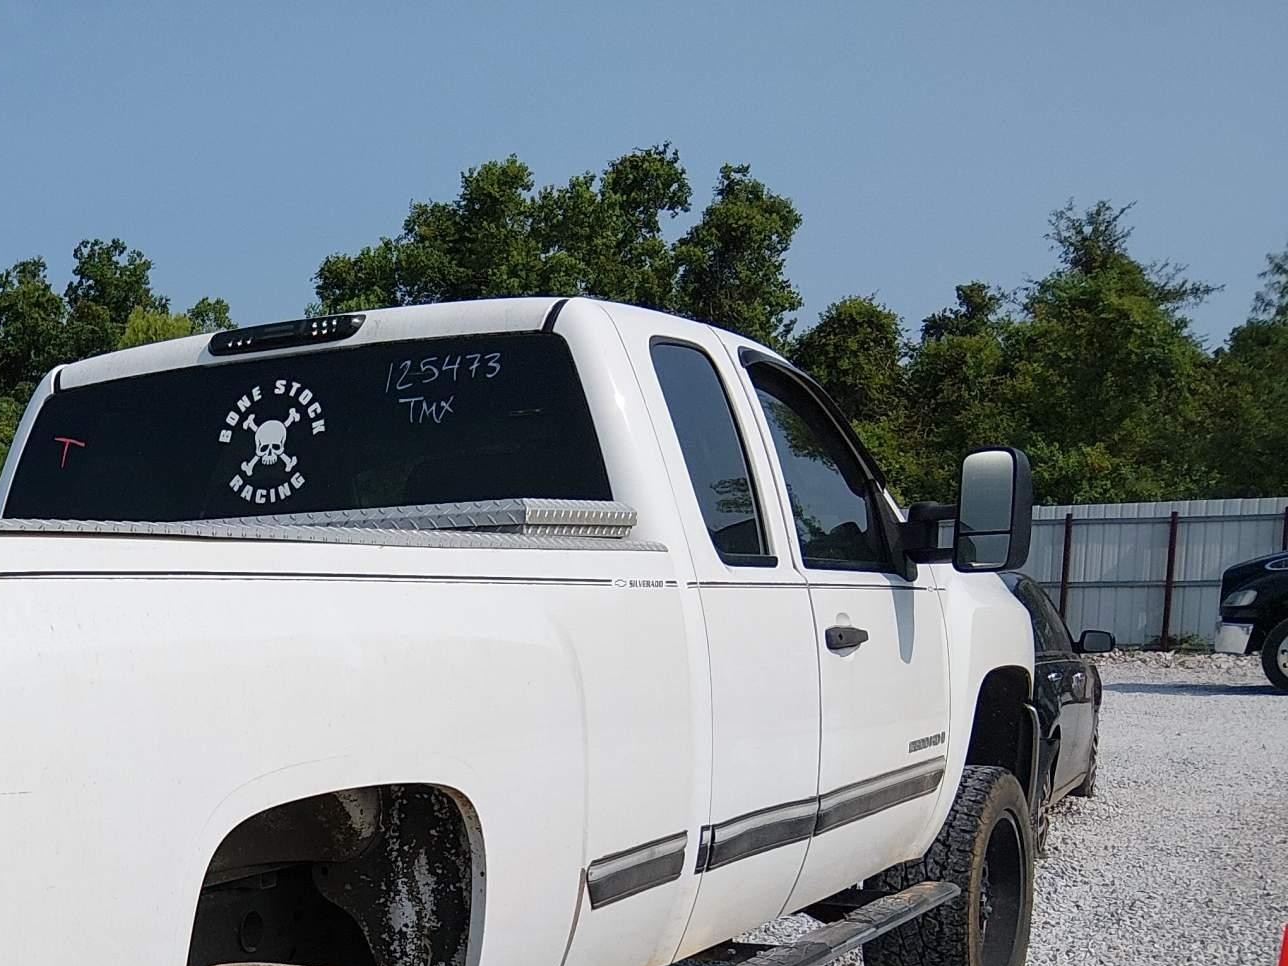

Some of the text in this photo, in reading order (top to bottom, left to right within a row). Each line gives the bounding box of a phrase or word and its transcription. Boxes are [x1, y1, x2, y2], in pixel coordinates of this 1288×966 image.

[385, 353, 502, 393] 125473
[218, 380, 326, 444] BONE STOCK
[398, 396, 455, 424] TMX
[228, 472, 305, 504] RACING
[629, 579, 664, 588] SILVERADO
